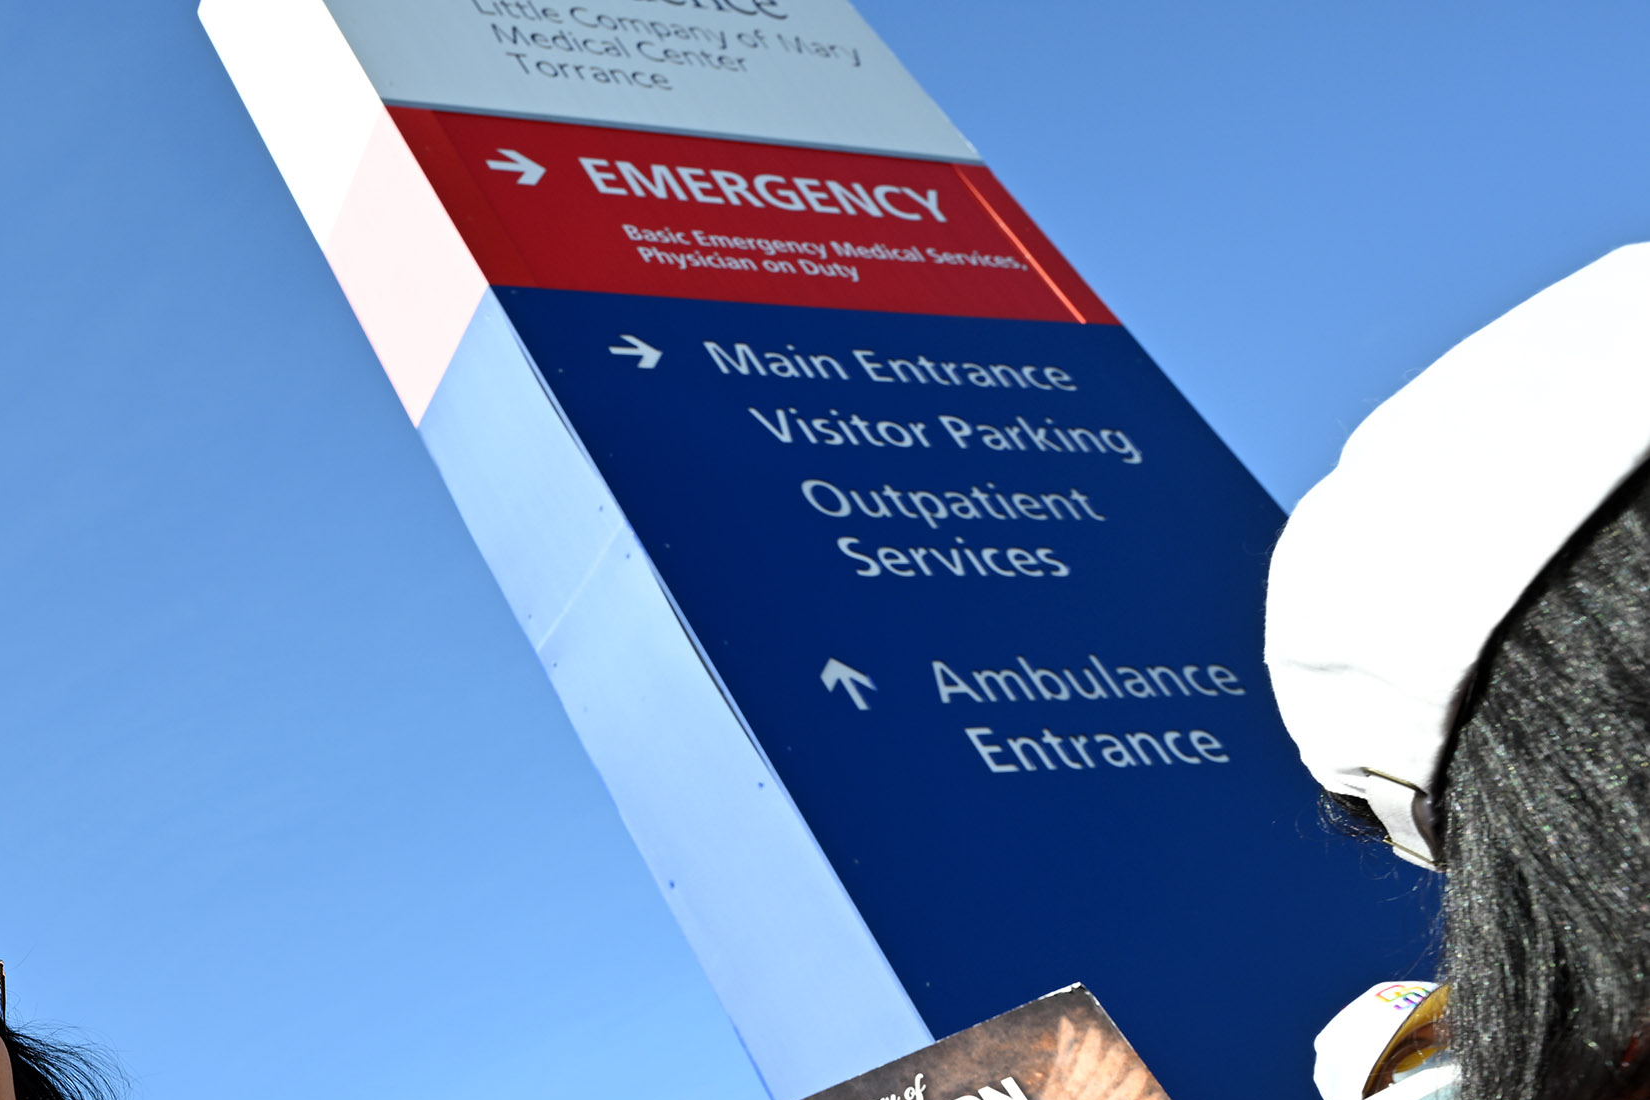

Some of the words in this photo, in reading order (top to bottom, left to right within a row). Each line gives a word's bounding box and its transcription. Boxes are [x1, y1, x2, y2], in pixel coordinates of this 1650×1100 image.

[489, 23, 631, 58] Medical
[636, 41, 747, 72] Center
[569, 6, 727, 50] Company
[736, 29, 767, 48] of
[777, 34, 861, 67] Mary
[505, 51, 673, 91] Torrance
[578, 156, 947, 223] EMERGENCY
[622, 223, 690, 247] Basic
[696, 230, 827, 259] Emergency
[830, 240, 925, 263] Medical
[926, 247, 1029, 272] Services,
[637, 246, 757, 273] Physician
[763, 259, 796, 275] on
[799, 258, 860, 282] Duty
[703, 341, 849, 380] Main
[852, 349, 1077, 391] Entrance
[748, 407, 932, 447] Visitor
[938, 415, 1142, 464] Parking
[801, 479, 1106, 528] Outpatient
[836, 536, 1071, 577] Services
[932, 654, 1246, 703] Ambulance
[965, 726, 1230, 773] Entrance
